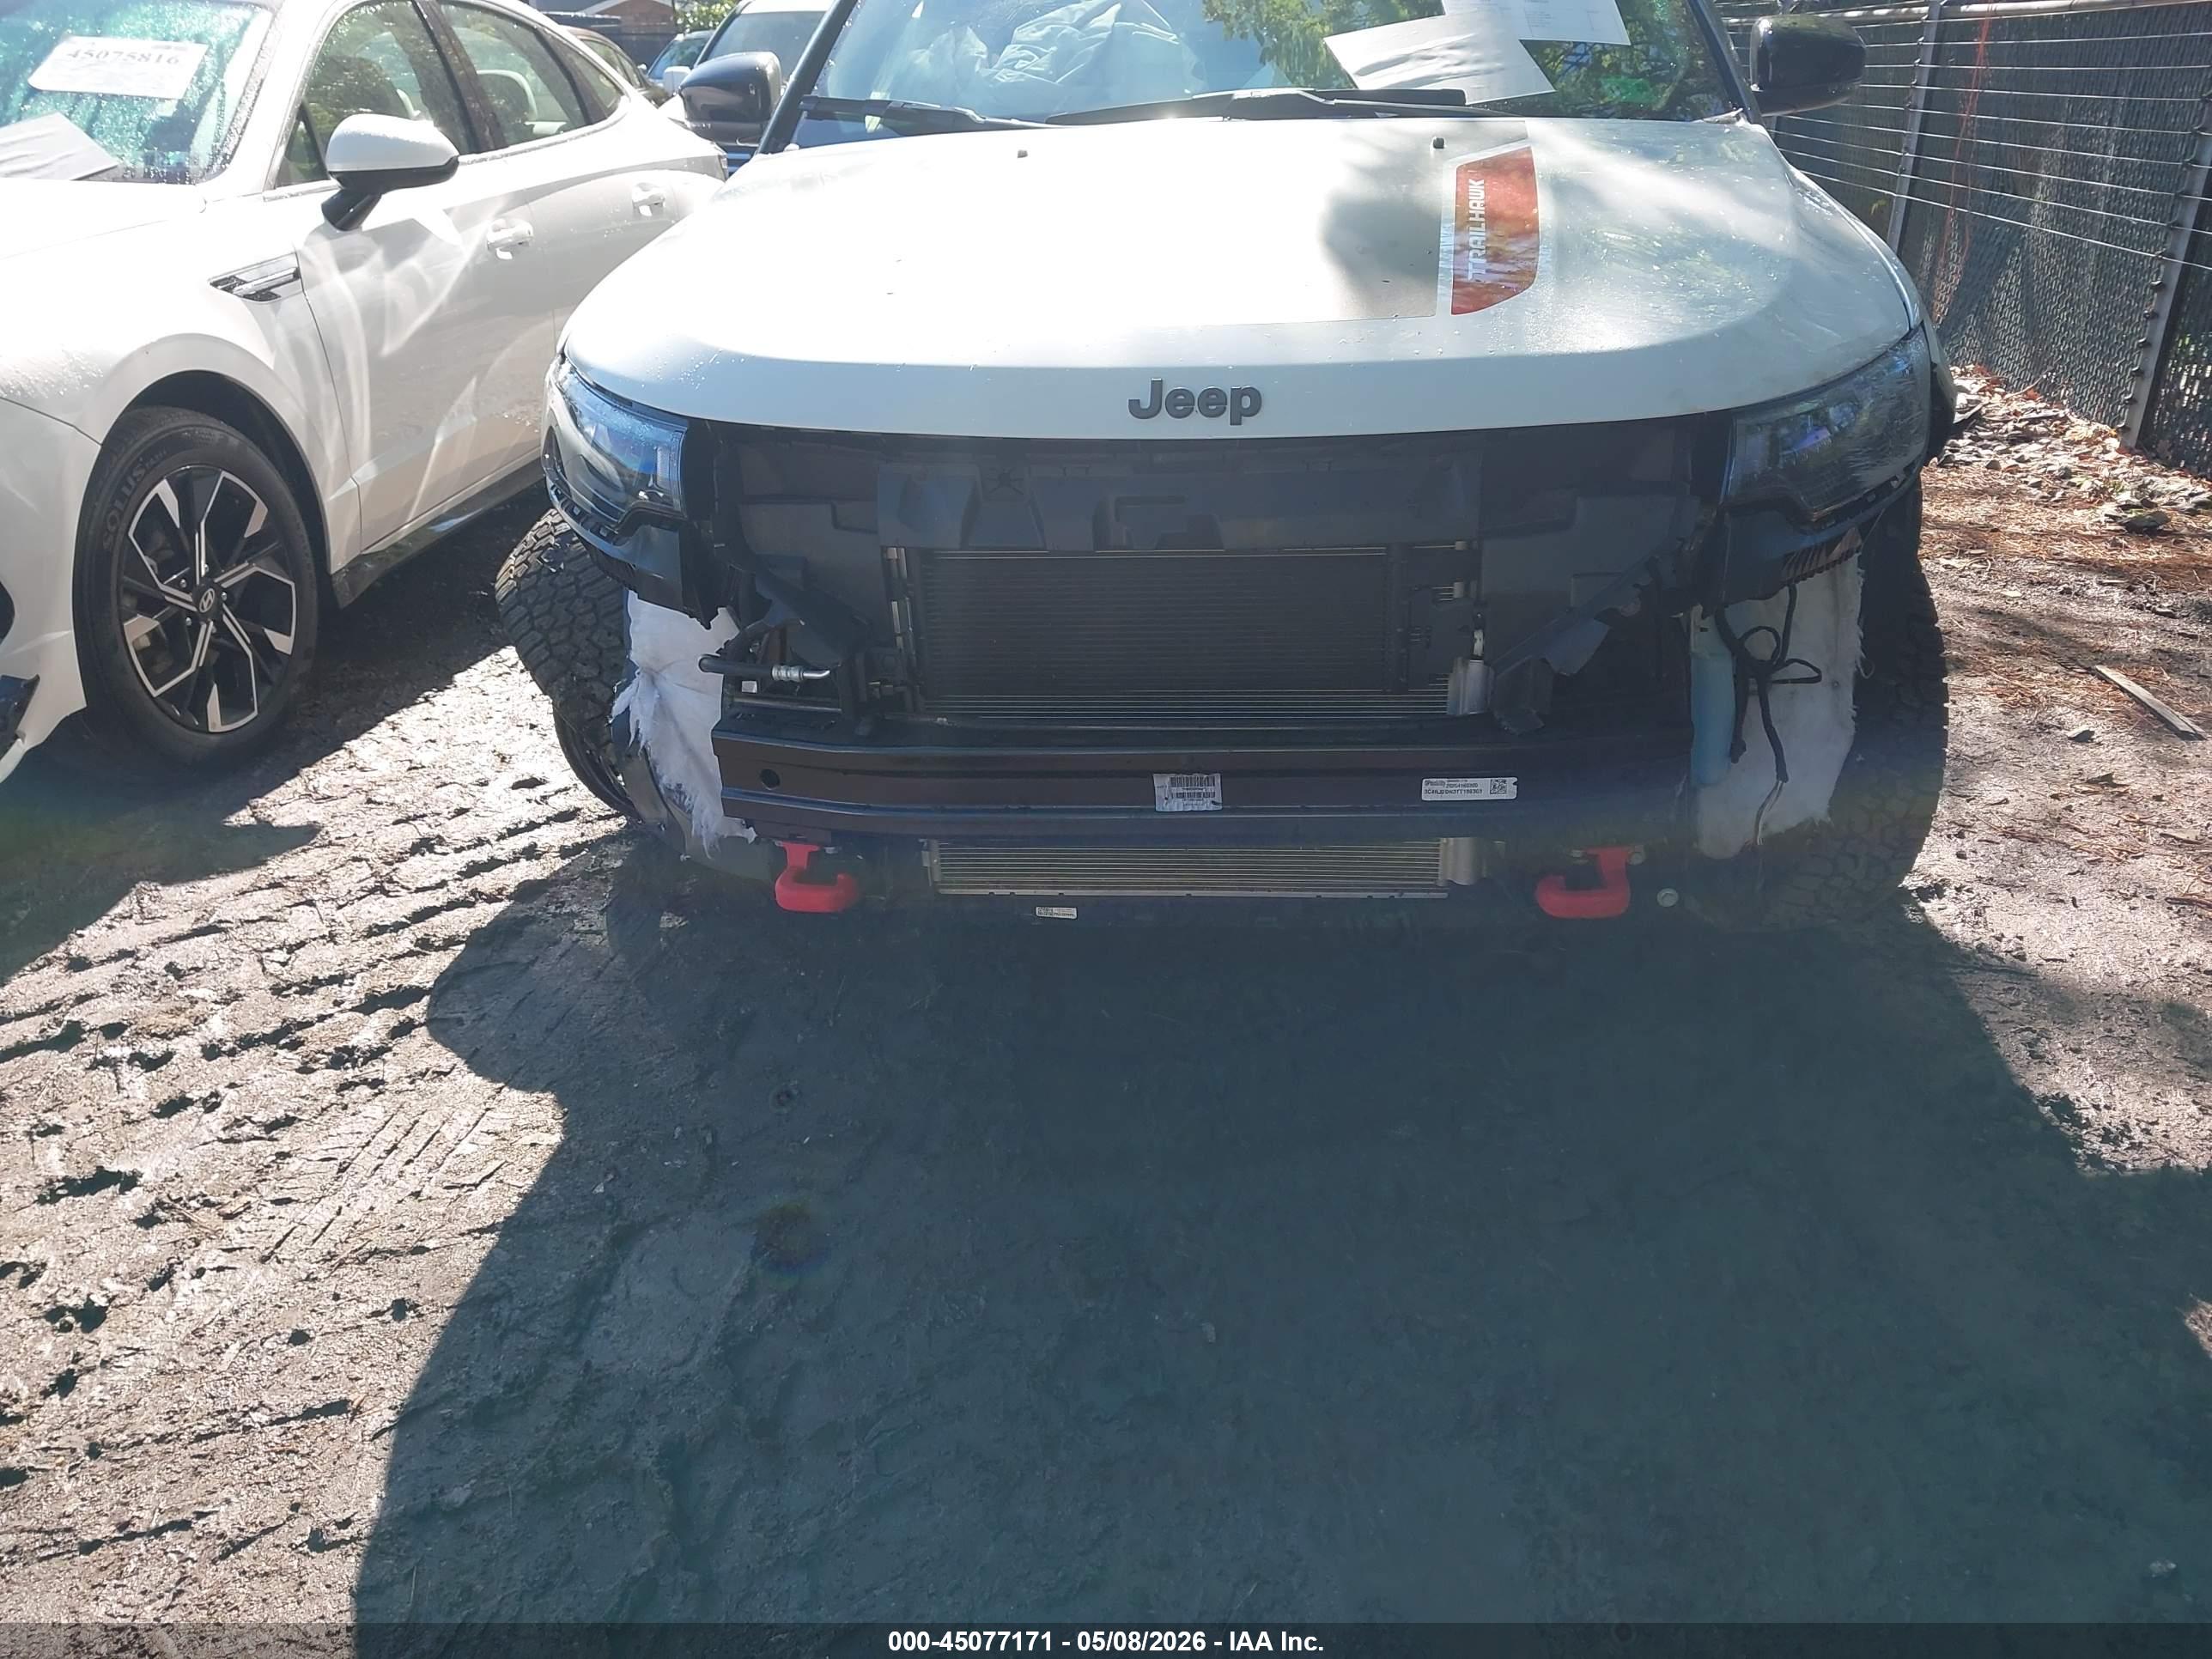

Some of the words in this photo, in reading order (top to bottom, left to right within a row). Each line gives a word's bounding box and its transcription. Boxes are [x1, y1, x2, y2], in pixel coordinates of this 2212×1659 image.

[66, 47, 180, 65] 45075816
[1467, 179, 1487, 282] TRAILHAWK
[1127, 378, 1262, 426] Jeep
[102, 465, 146, 550] SOLUS
